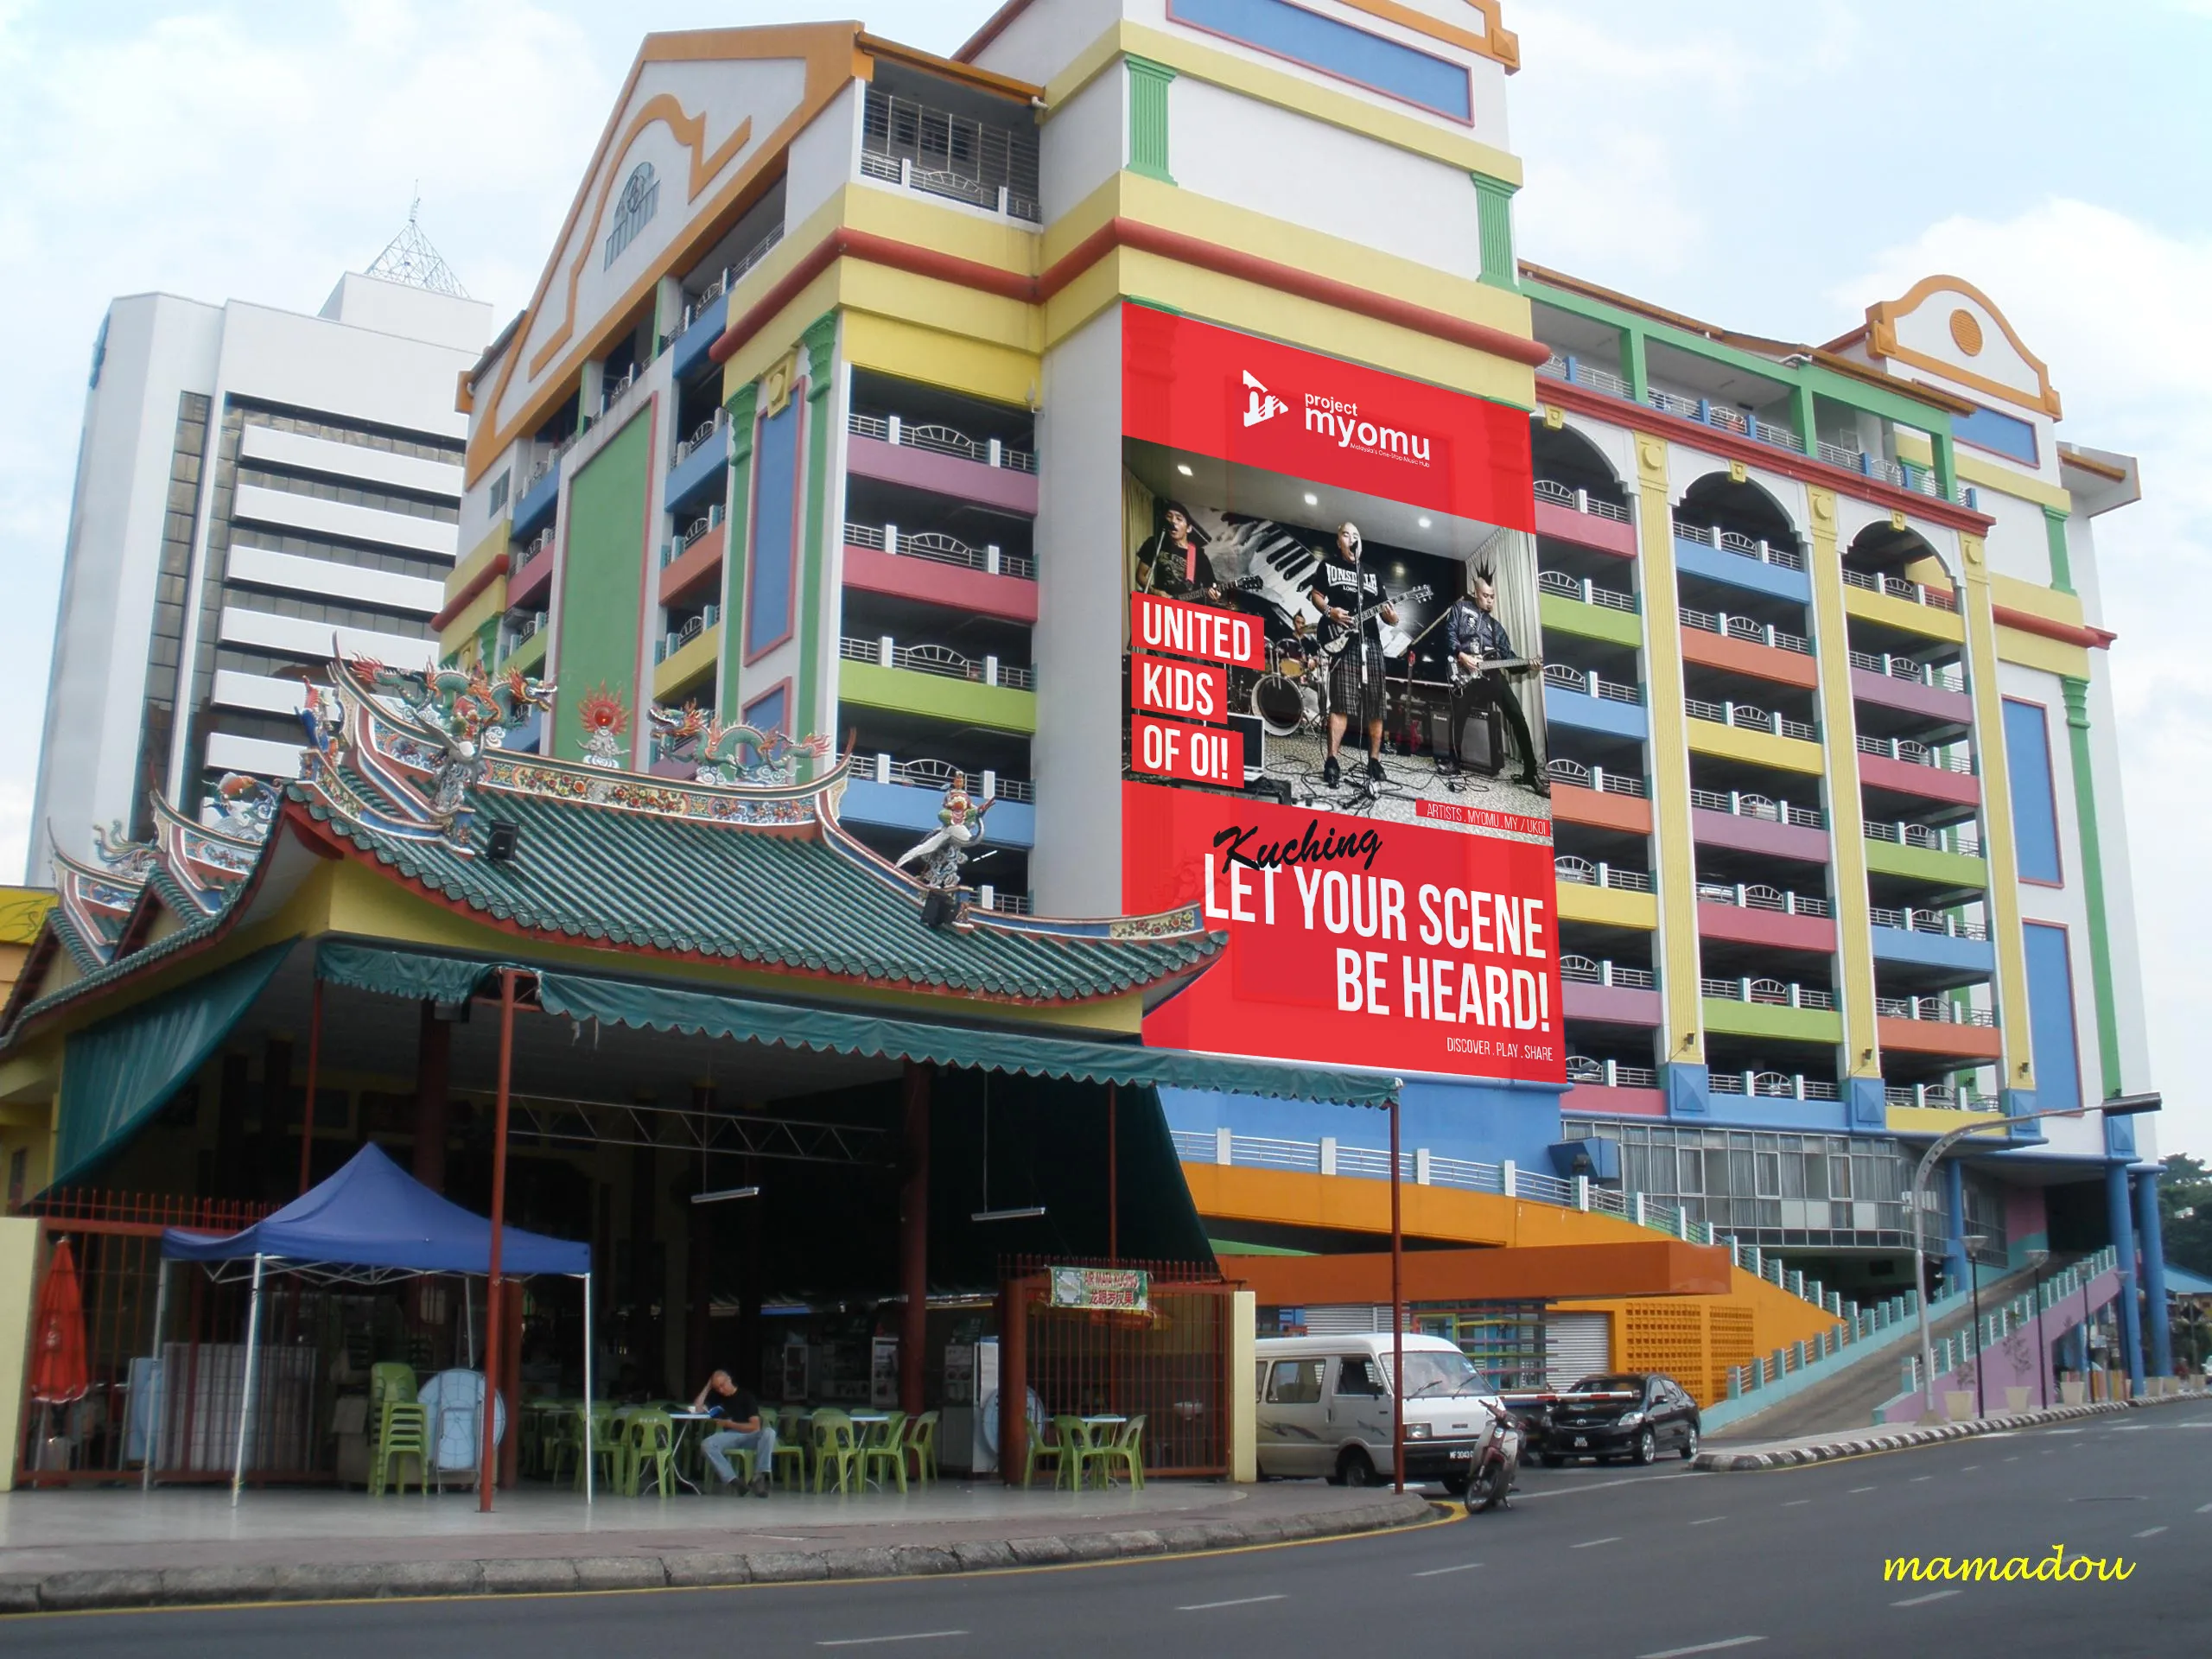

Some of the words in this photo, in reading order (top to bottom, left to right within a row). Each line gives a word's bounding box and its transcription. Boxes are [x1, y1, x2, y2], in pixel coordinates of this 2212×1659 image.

[1305, 392, 1358, 416] project
[1305, 407, 1430, 461] myomu
[1419, 459, 1430, 468] Hub
[1143, 601, 1251, 663] UNITED
[1143, 662, 1214, 716] KIDS
[1143, 724, 1181, 772] OF
[1190, 732, 1229, 780] OI!
[1213, 819, 1383, 874] Kuching
[1205, 853, 1282, 925] LET
[1293, 865, 1408, 942] YOUR
[1418, 883, 1547, 959] SCENE
[1336, 947, 1390, 1015] BE
[1402, 955, 1550, 1033] HEARD!
[1496, 1041, 1518, 1058] PLAY
[1524, 1045, 1554, 1062] SHARE
